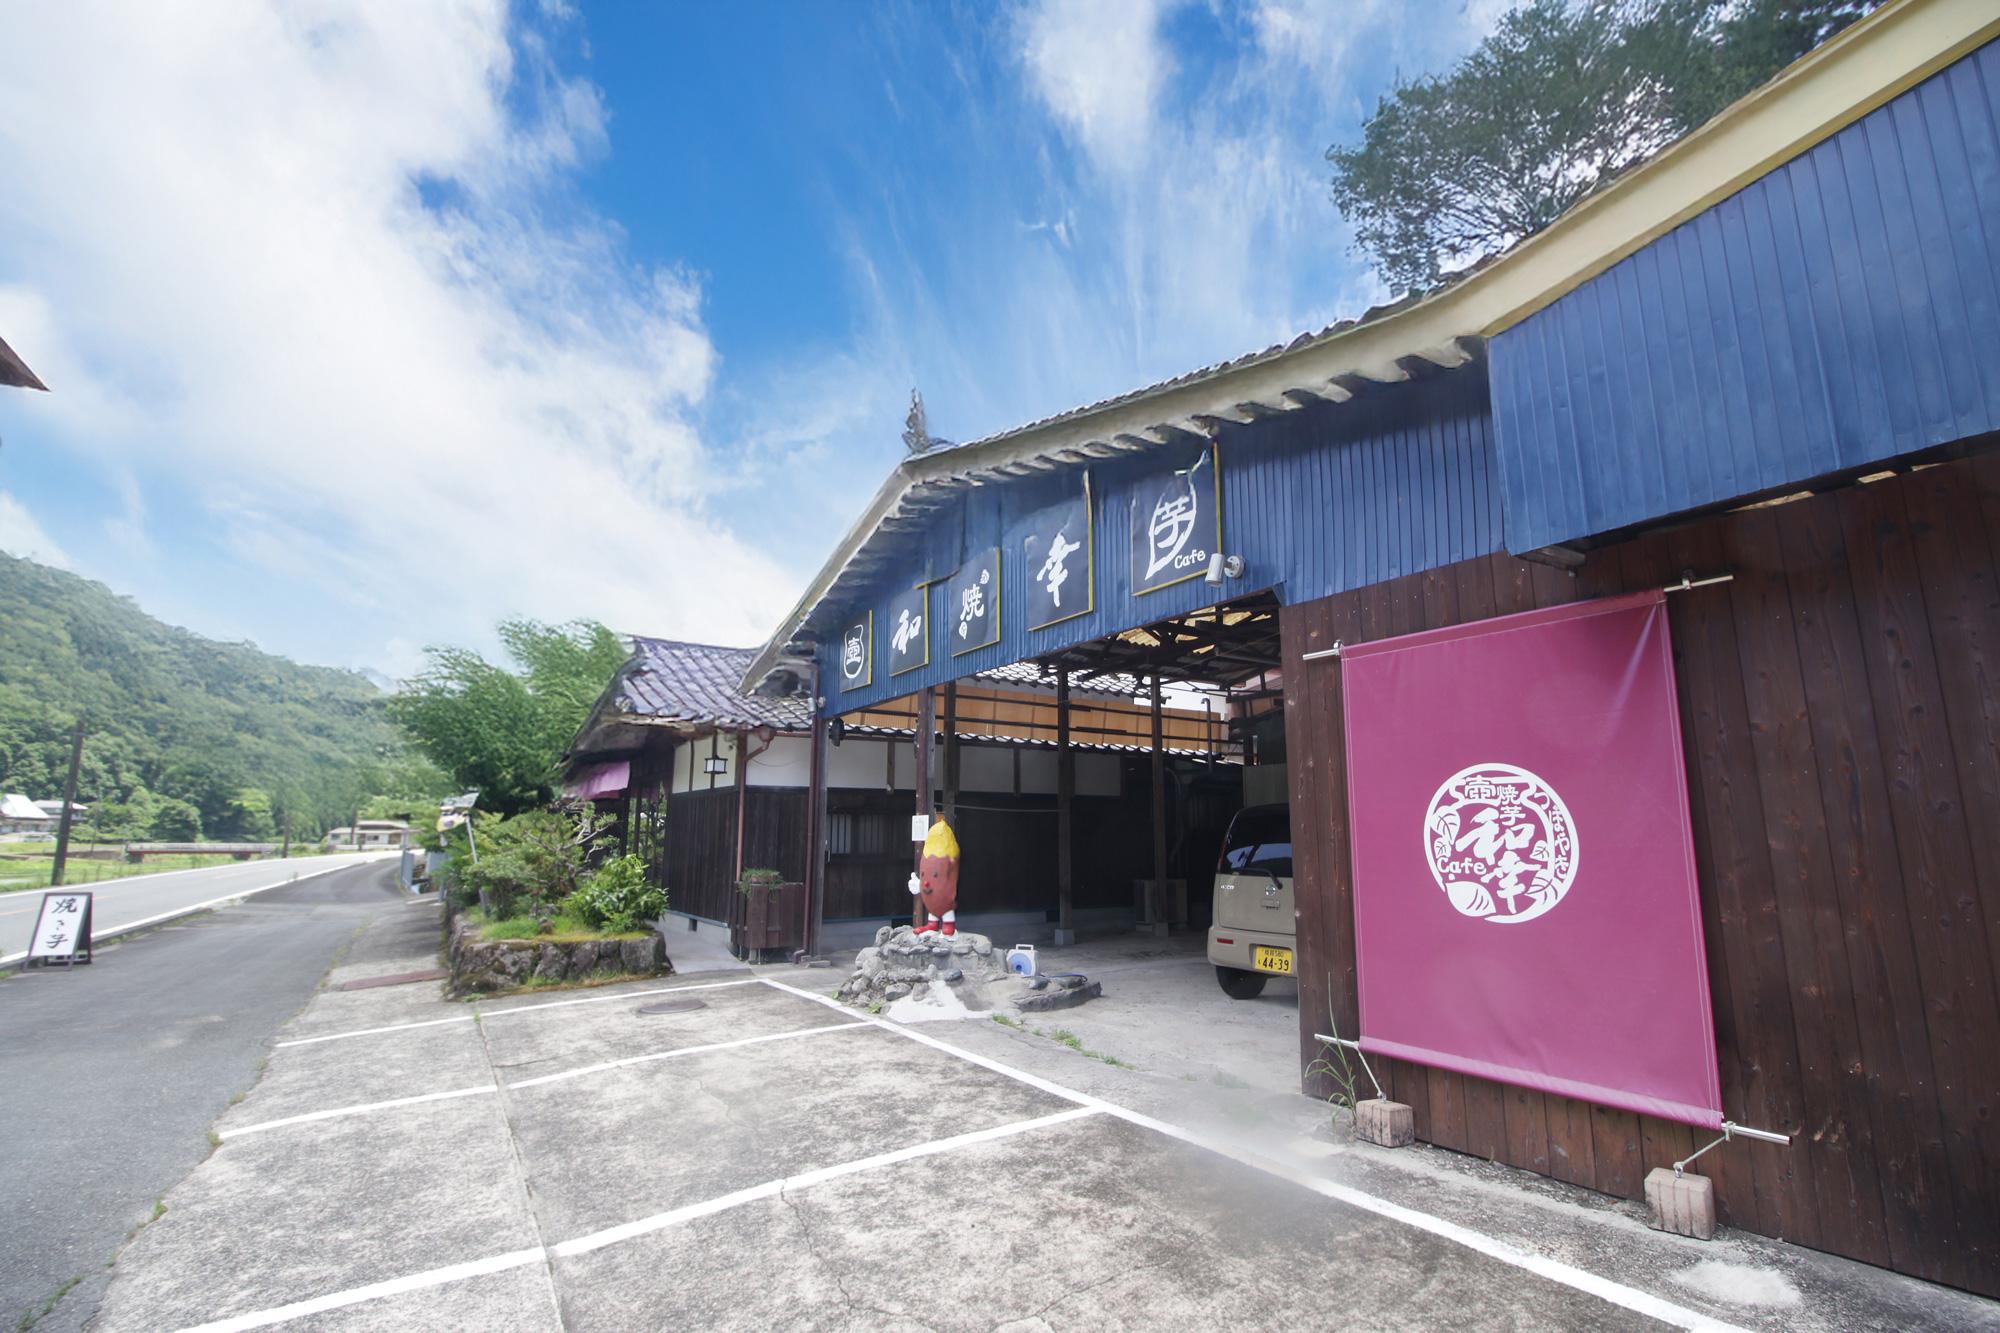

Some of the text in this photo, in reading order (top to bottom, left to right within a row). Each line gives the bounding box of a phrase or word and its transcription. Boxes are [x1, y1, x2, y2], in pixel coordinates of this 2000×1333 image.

[1174, 548, 1207, 570] Cafe
[1436, 856, 1487, 875] Cafe
[1262, 957, 1290, 972] 44-39
